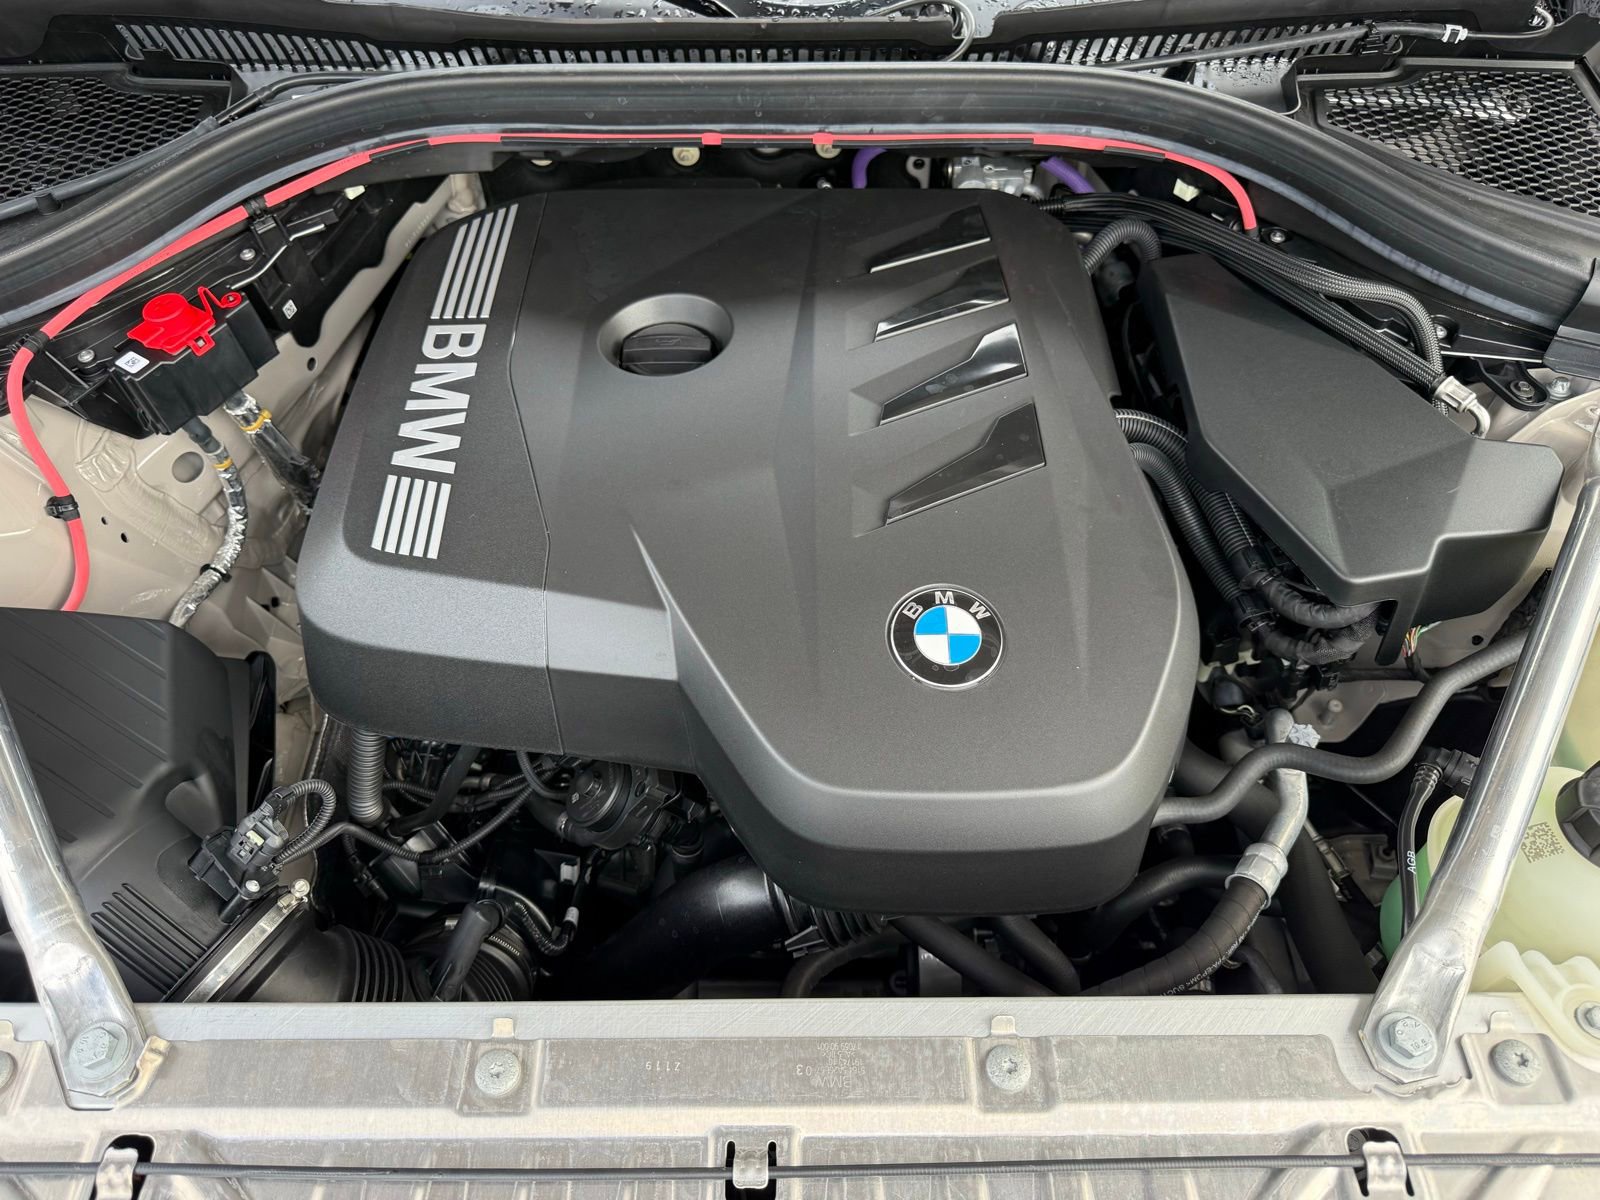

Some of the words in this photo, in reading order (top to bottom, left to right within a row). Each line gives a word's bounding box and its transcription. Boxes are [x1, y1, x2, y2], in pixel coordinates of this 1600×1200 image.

[391, 323, 487, 475] BMW
[902, 591, 991, 620] BMW
[1406, 850, 1417, 875] AGB
[814, 1075, 852, 1089] BMW
